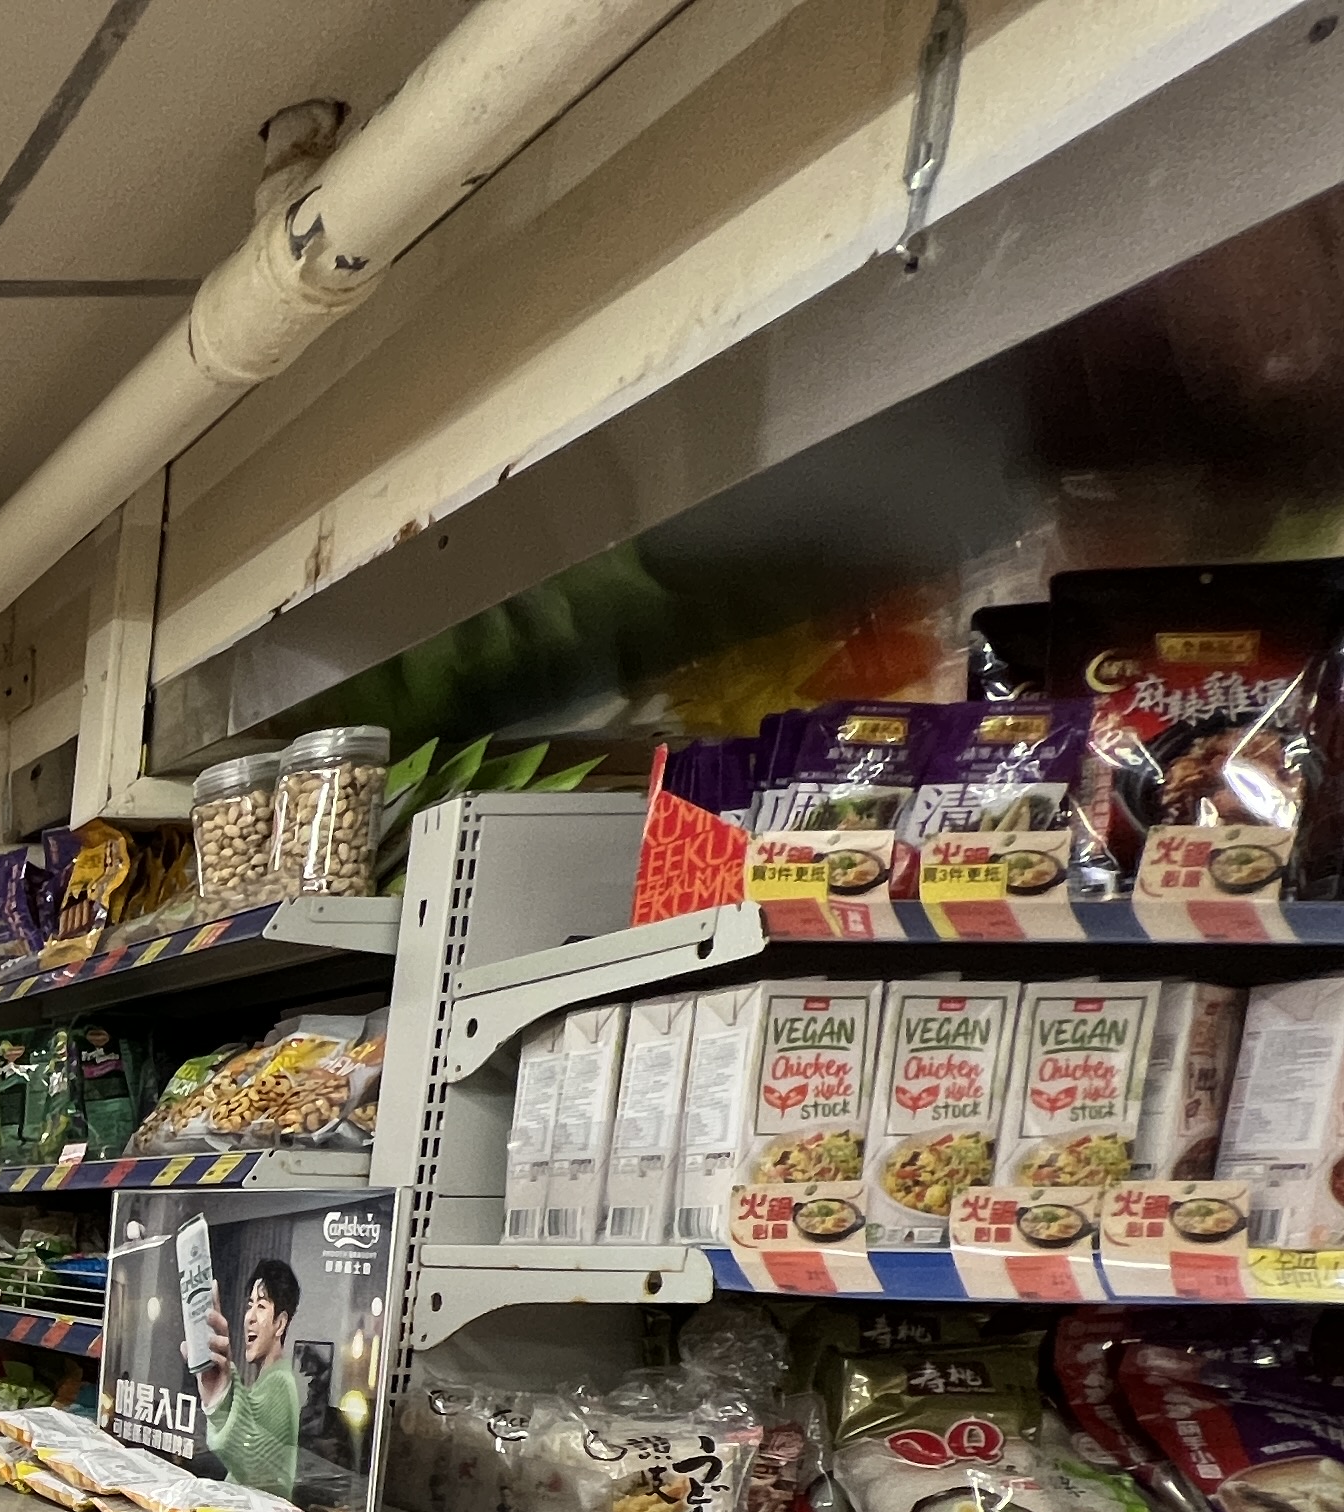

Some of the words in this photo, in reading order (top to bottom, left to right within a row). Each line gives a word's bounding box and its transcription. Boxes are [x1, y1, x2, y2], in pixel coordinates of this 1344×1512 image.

[774, 1016, 856, 1046] VEGAN
[905, 1017, 991, 1046] VEGAN
[1040, 1017, 1128, 1046] VEGAN
[771, 1054, 853, 1082] Chicken
[904, 1054, 984, 1082] Chicken
[1039, 1055, 1117, 1082] Chicken
[739, 1194, 794, 1221] 火鍋
[323, 1211, 381, 1247] Carlsberg
